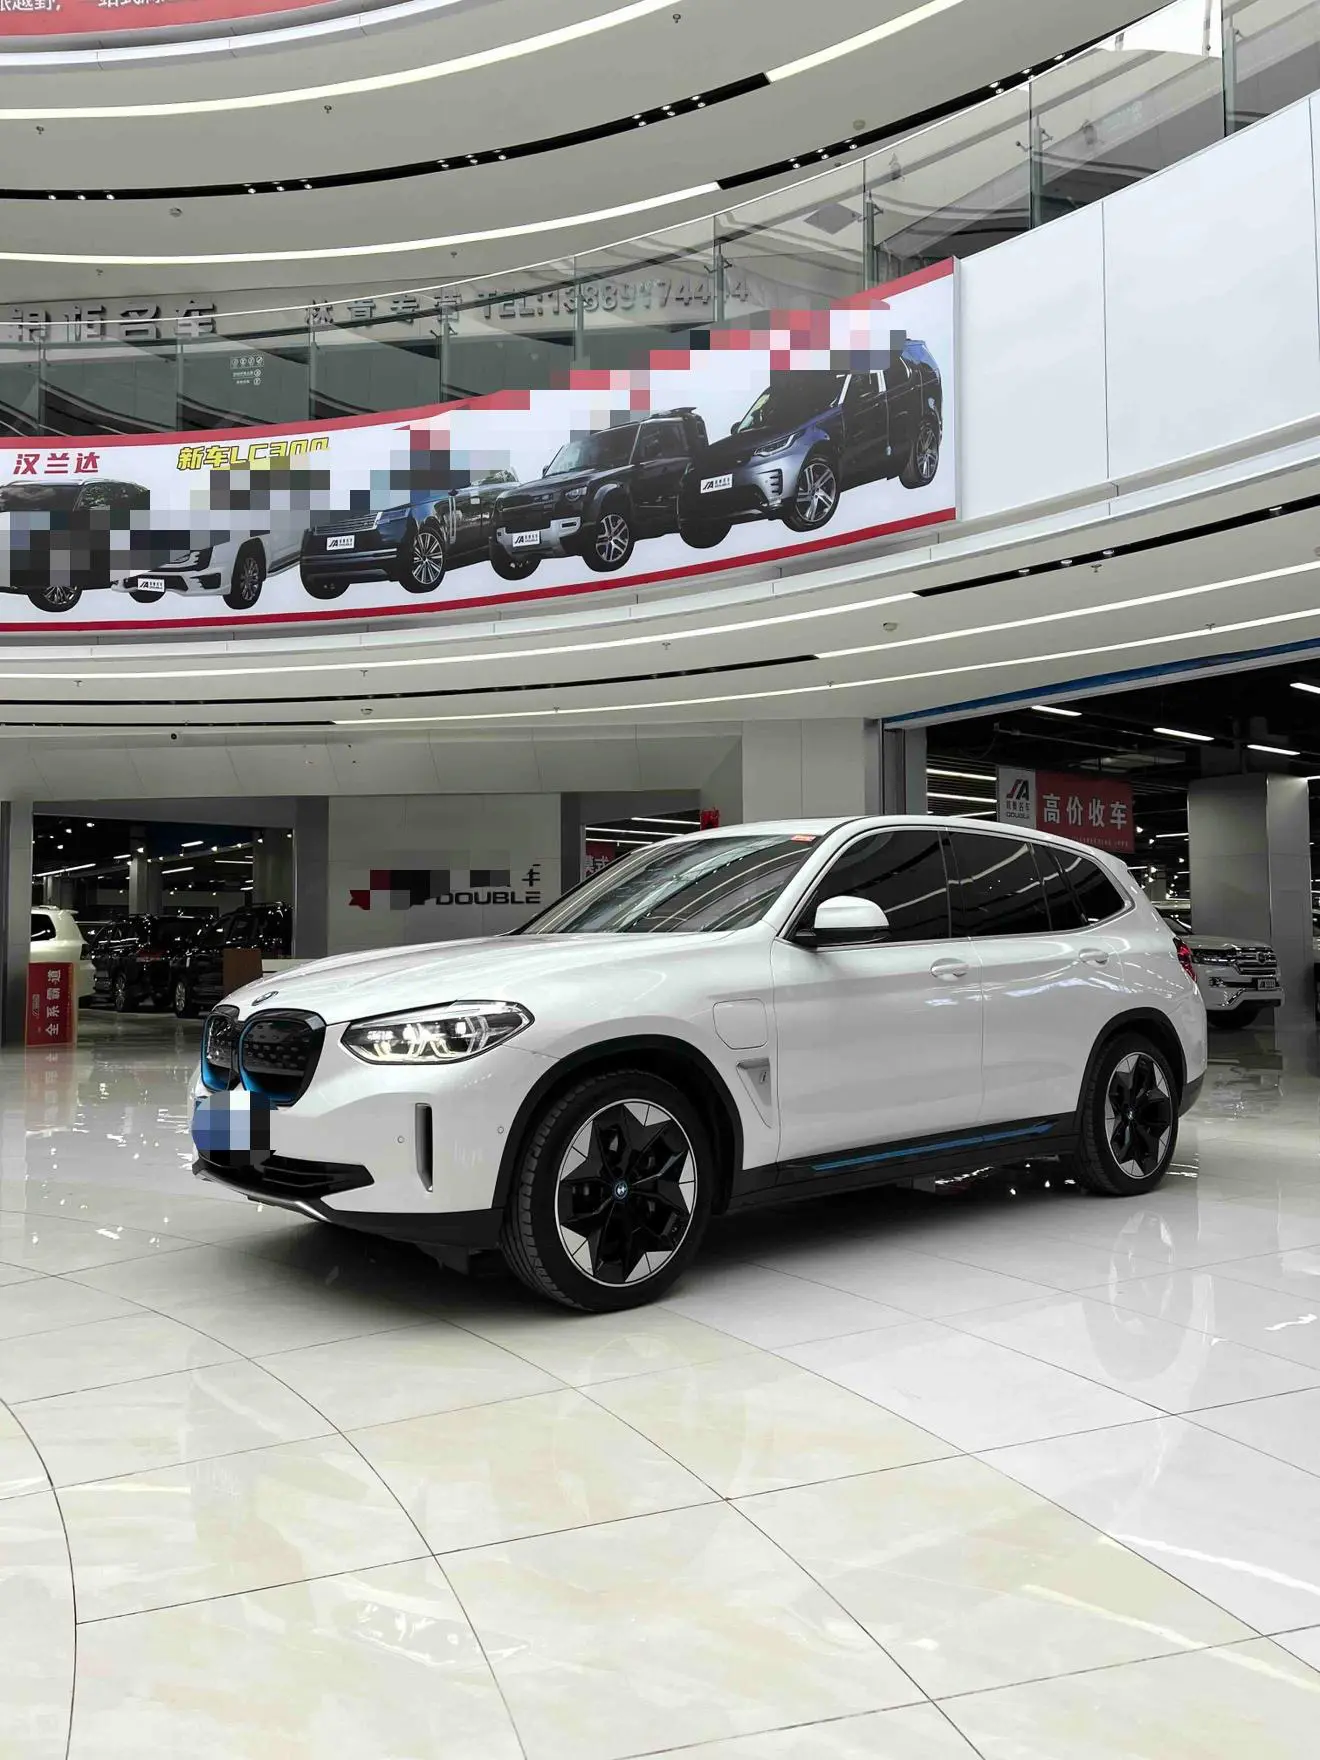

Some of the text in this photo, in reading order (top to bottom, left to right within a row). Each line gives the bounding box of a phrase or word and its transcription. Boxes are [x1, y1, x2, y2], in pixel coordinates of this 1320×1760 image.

[13, 452, 100, 475] 汉兰达
[1042, 792, 1128, 830] 高价收车
[435, 891, 541, 905] DOUBLE
[45, 969, 61, 1037] 全系霸道
